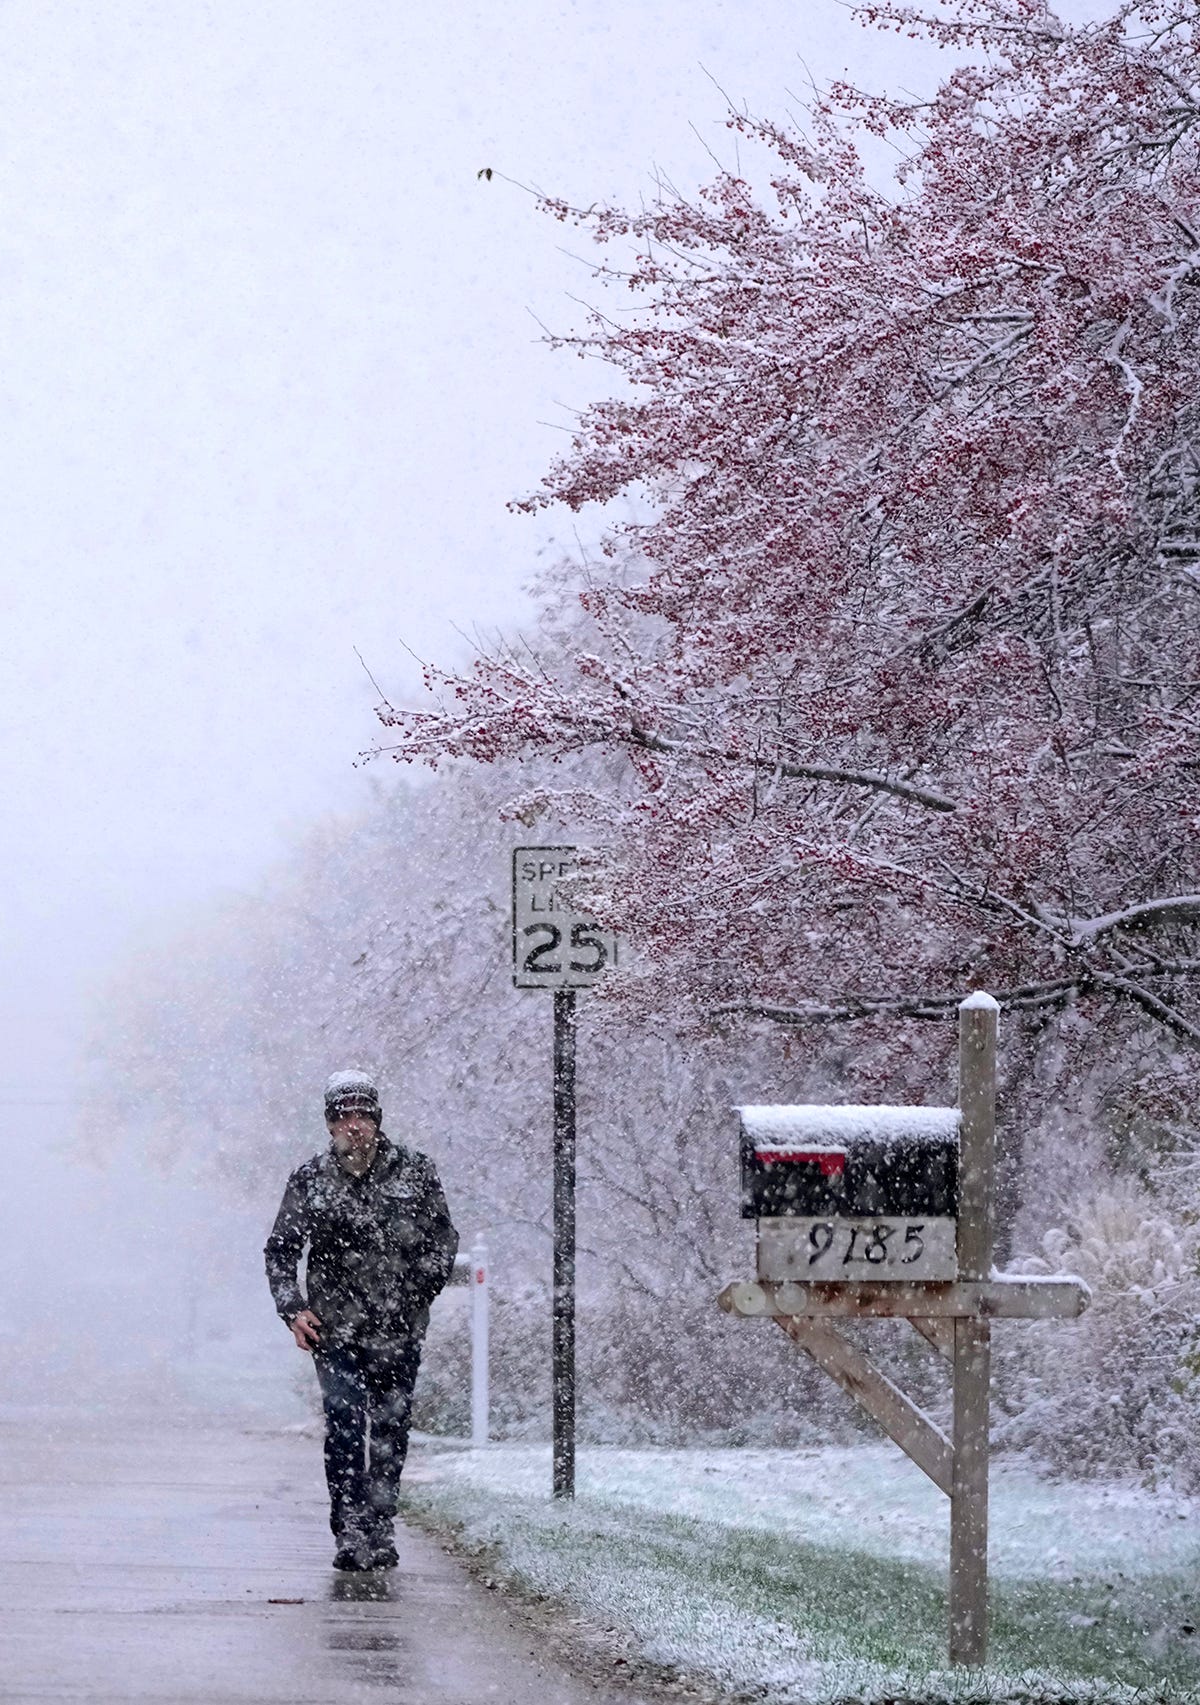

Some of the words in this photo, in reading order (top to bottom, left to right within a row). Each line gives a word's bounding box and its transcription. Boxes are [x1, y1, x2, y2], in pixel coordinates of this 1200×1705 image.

[522, 861, 574, 881] SPE
[523, 922, 608, 973] 25
[809, 1222, 925, 1265] 9185
